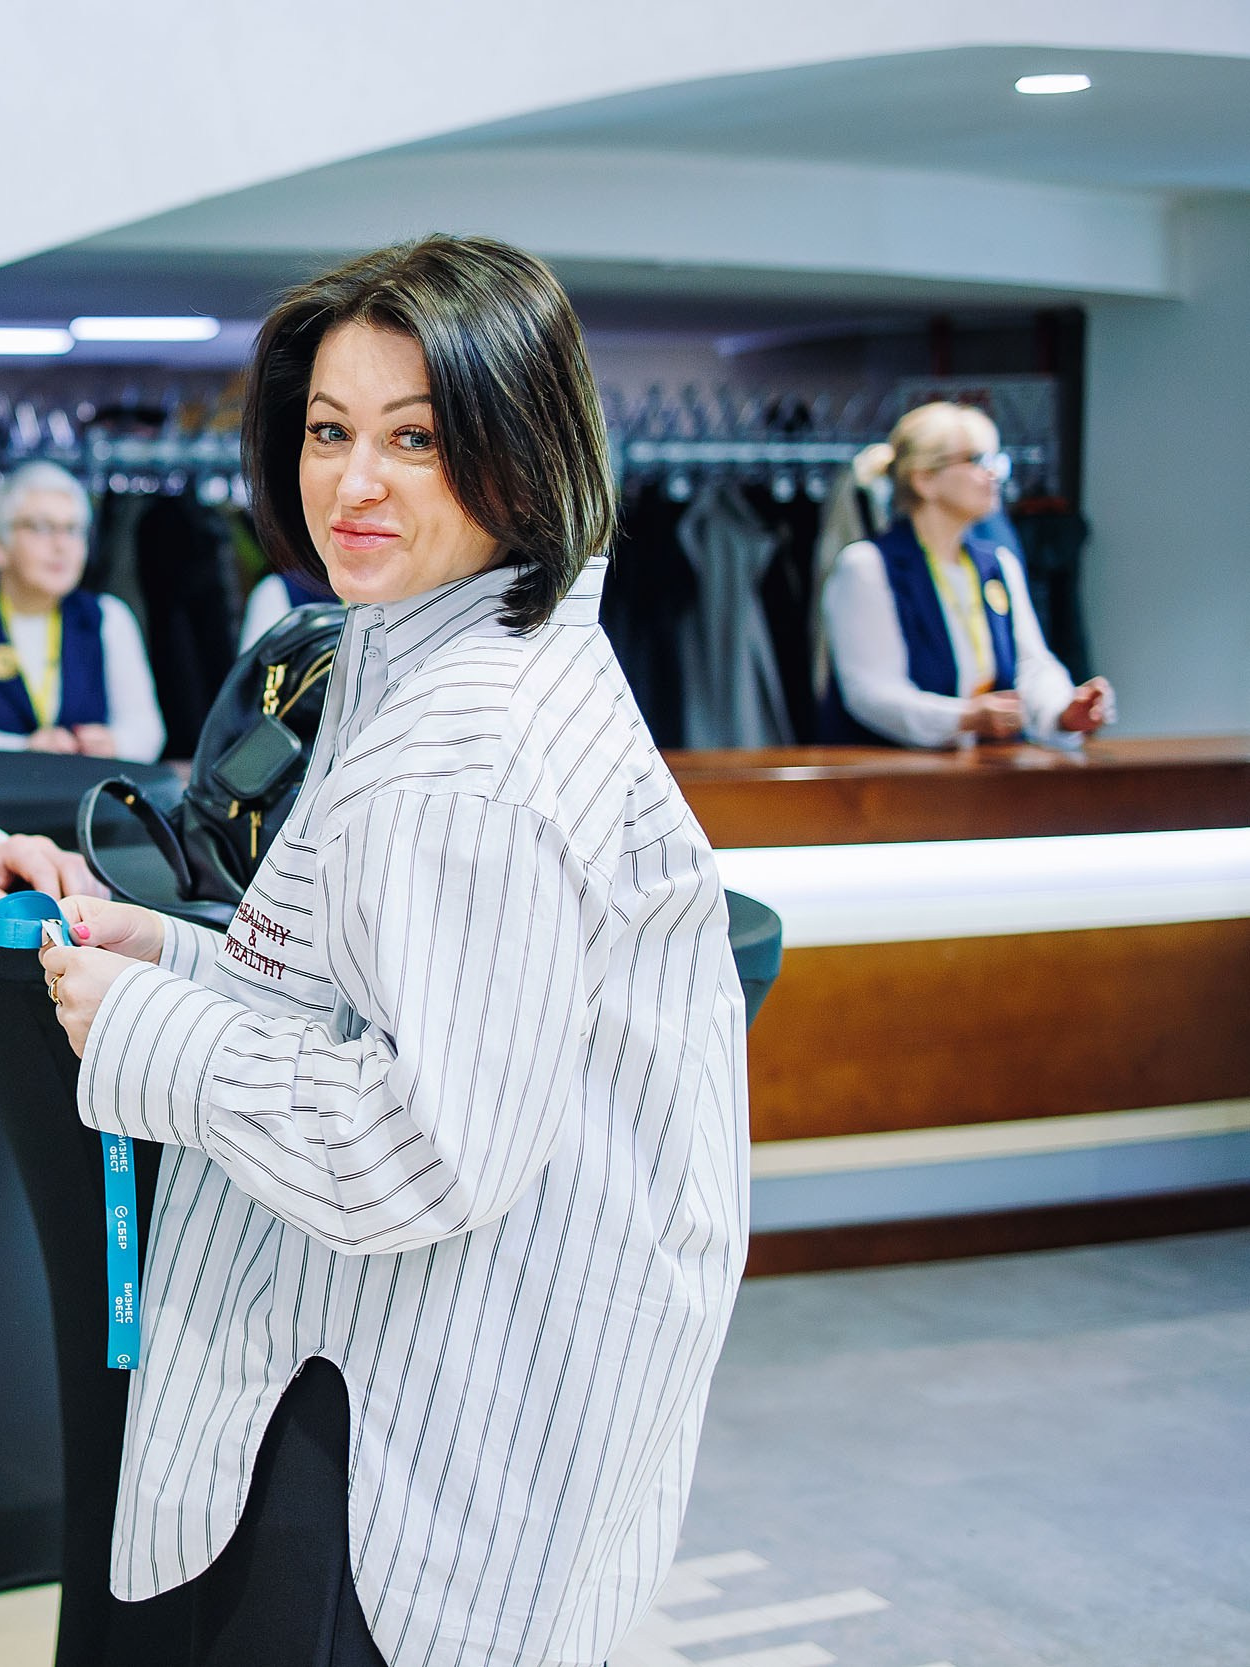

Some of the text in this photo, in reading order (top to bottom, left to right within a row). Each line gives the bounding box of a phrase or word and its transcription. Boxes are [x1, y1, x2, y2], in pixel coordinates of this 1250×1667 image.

[248, 928, 257, 948] &
[224, 934, 286, 979] WEALTHY
[109, 1146, 119, 1173] ФЕСТ
[117, 1220, 128, 1250] СБЕР
[114, 1296, 124, 1324] ФЕСТ
[123, 1282, 133, 1324] БИЗНЕС
